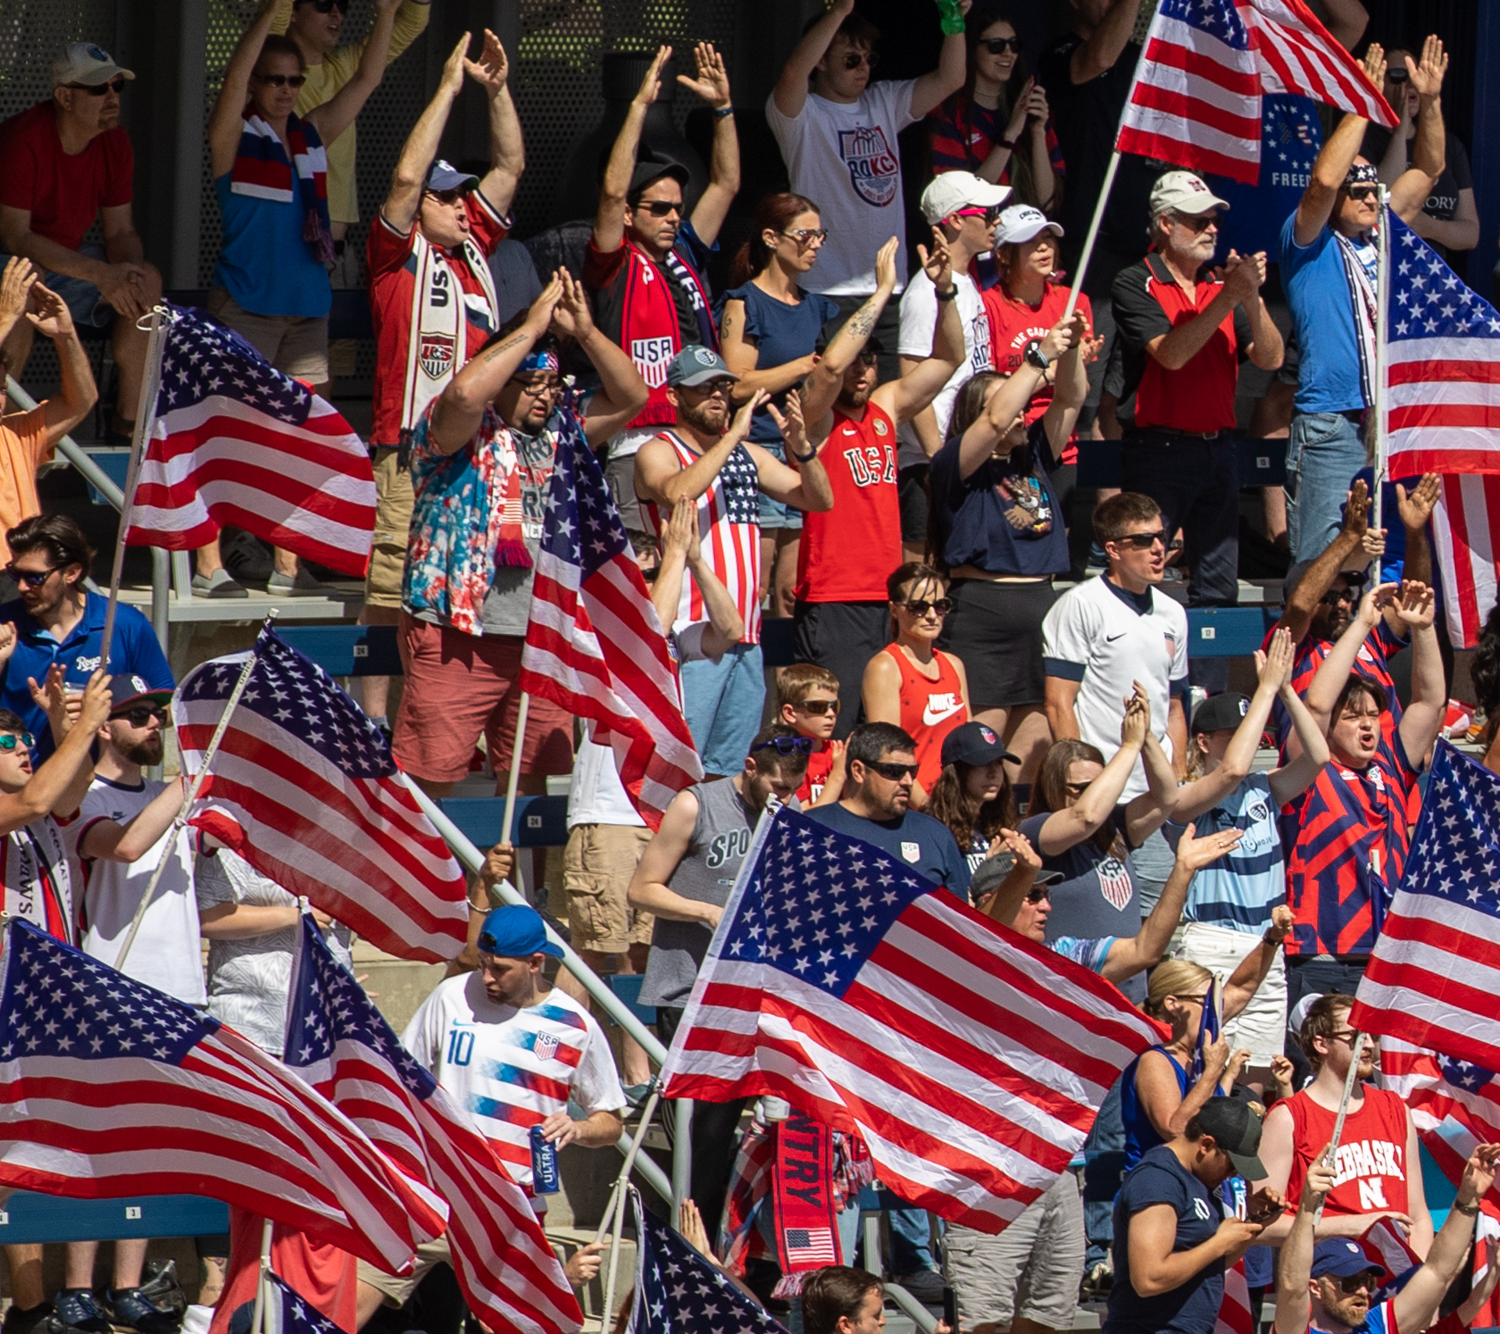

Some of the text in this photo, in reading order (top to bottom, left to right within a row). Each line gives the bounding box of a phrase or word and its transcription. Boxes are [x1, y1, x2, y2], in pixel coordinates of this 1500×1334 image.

[632, 341, 674, 363] USA
[843, 445, 897, 487] USA
[928, 693, 956, 711] NIKE
[447, 1030, 475, 1067] 10
[538, 1033, 558, 1046] USA
[543, 1142, 557, 1184] ULTRA
[1328, 1139, 1406, 1187] EBRASK
[1358, 1175, 1390, 1210] N
